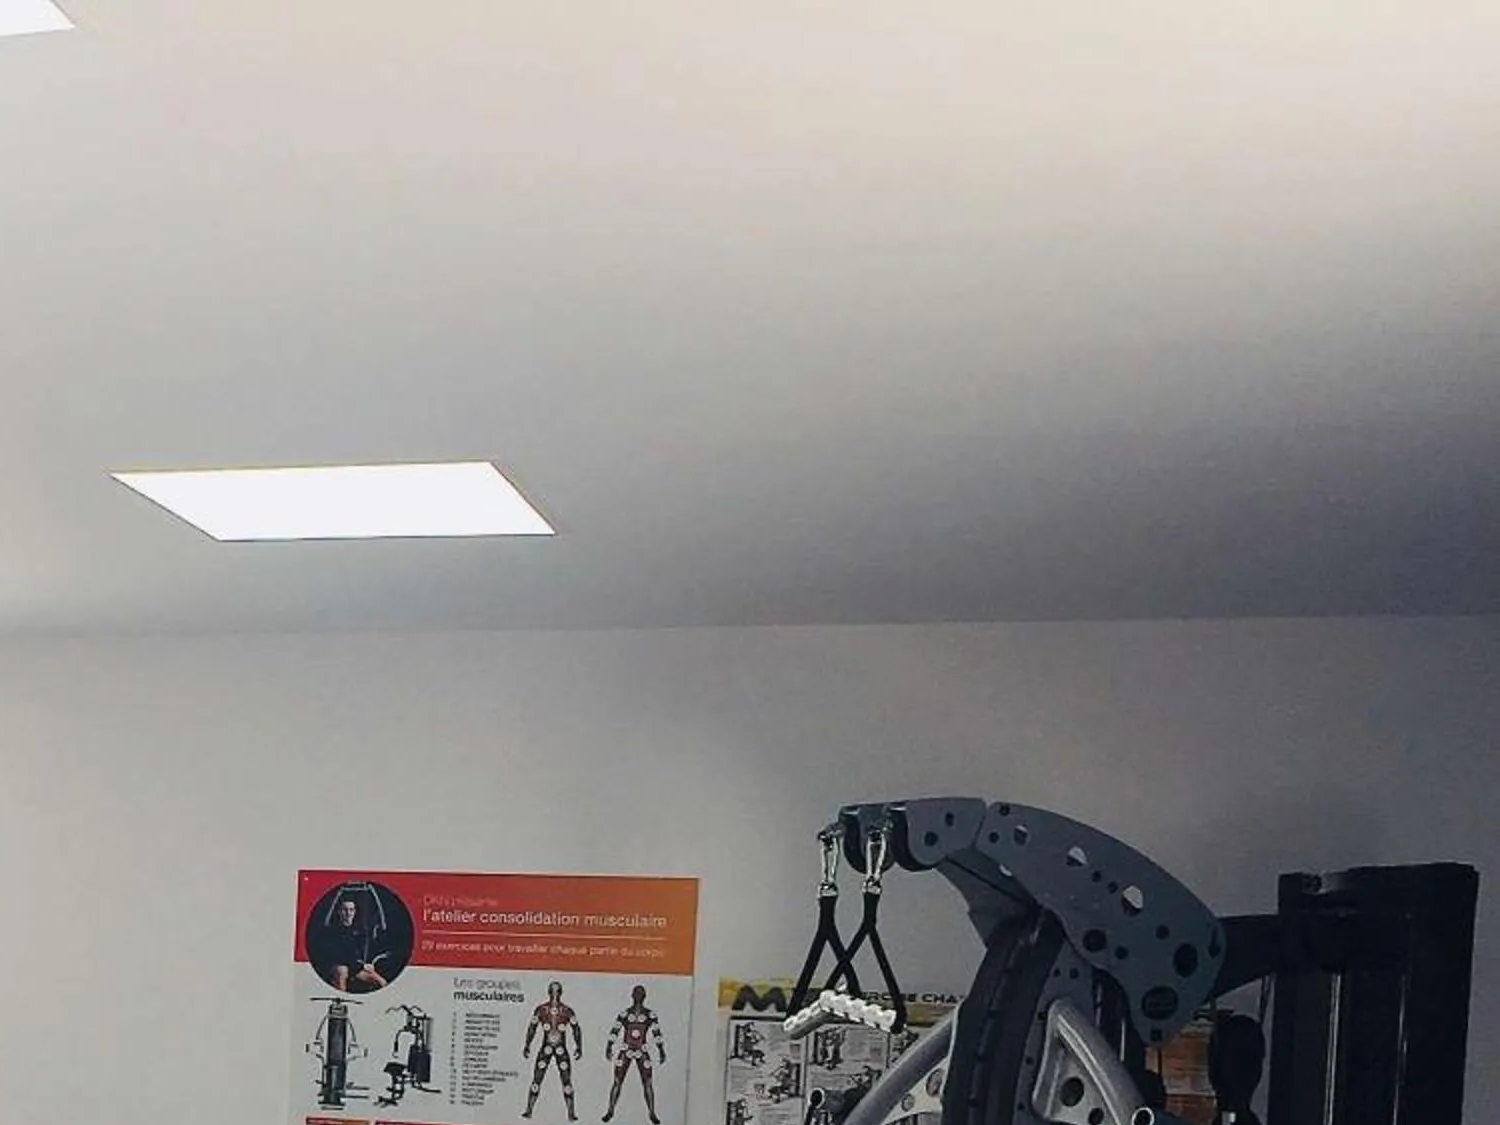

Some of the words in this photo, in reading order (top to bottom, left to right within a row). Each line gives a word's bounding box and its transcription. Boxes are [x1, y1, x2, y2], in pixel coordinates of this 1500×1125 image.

[423, 909, 479, 924] l'atelier
[480, 911, 580, 927] consolidation
[584, 914, 668, 929] musculaire
[453, 990, 525, 1003] musculaires
